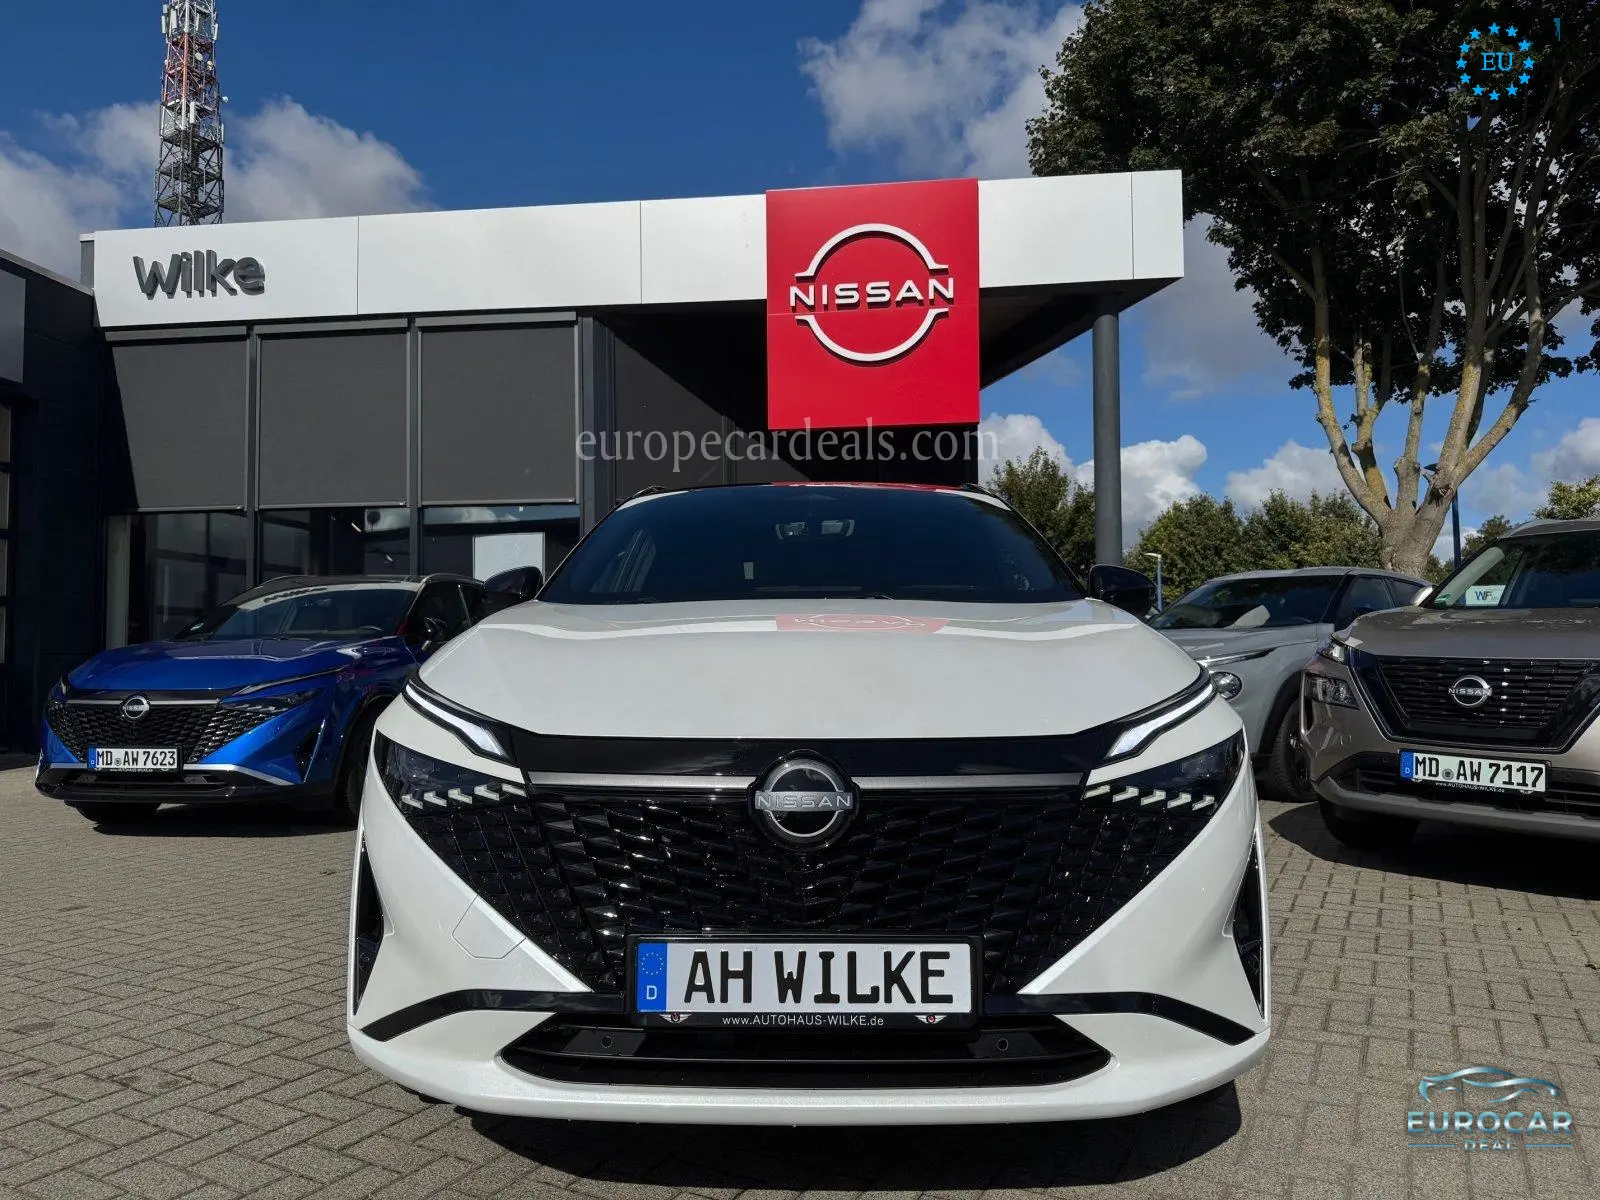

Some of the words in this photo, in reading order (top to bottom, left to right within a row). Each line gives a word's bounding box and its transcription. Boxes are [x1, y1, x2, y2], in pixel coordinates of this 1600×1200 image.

[133, 250, 265, 300] Wilke
[789, 278, 954, 309] NISSAN
[96, 750, 113, 766] MD
[123, 750, 139, 766] AW
[142, 750, 176, 766] 7623
[1414, 755, 1440, 778] MD
[1456, 760, 1482, 783] AW
[1488, 762, 1544, 788] 7117
[757, 795, 851, 808] NISSAN
[683, 950, 753, 1004] AH
[773, 950, 953, 1004] WILKE
[646, 985, 658, 1000] D
[722, 1014, 884, 1026] www.AUTOHAUS-WILKE.de
